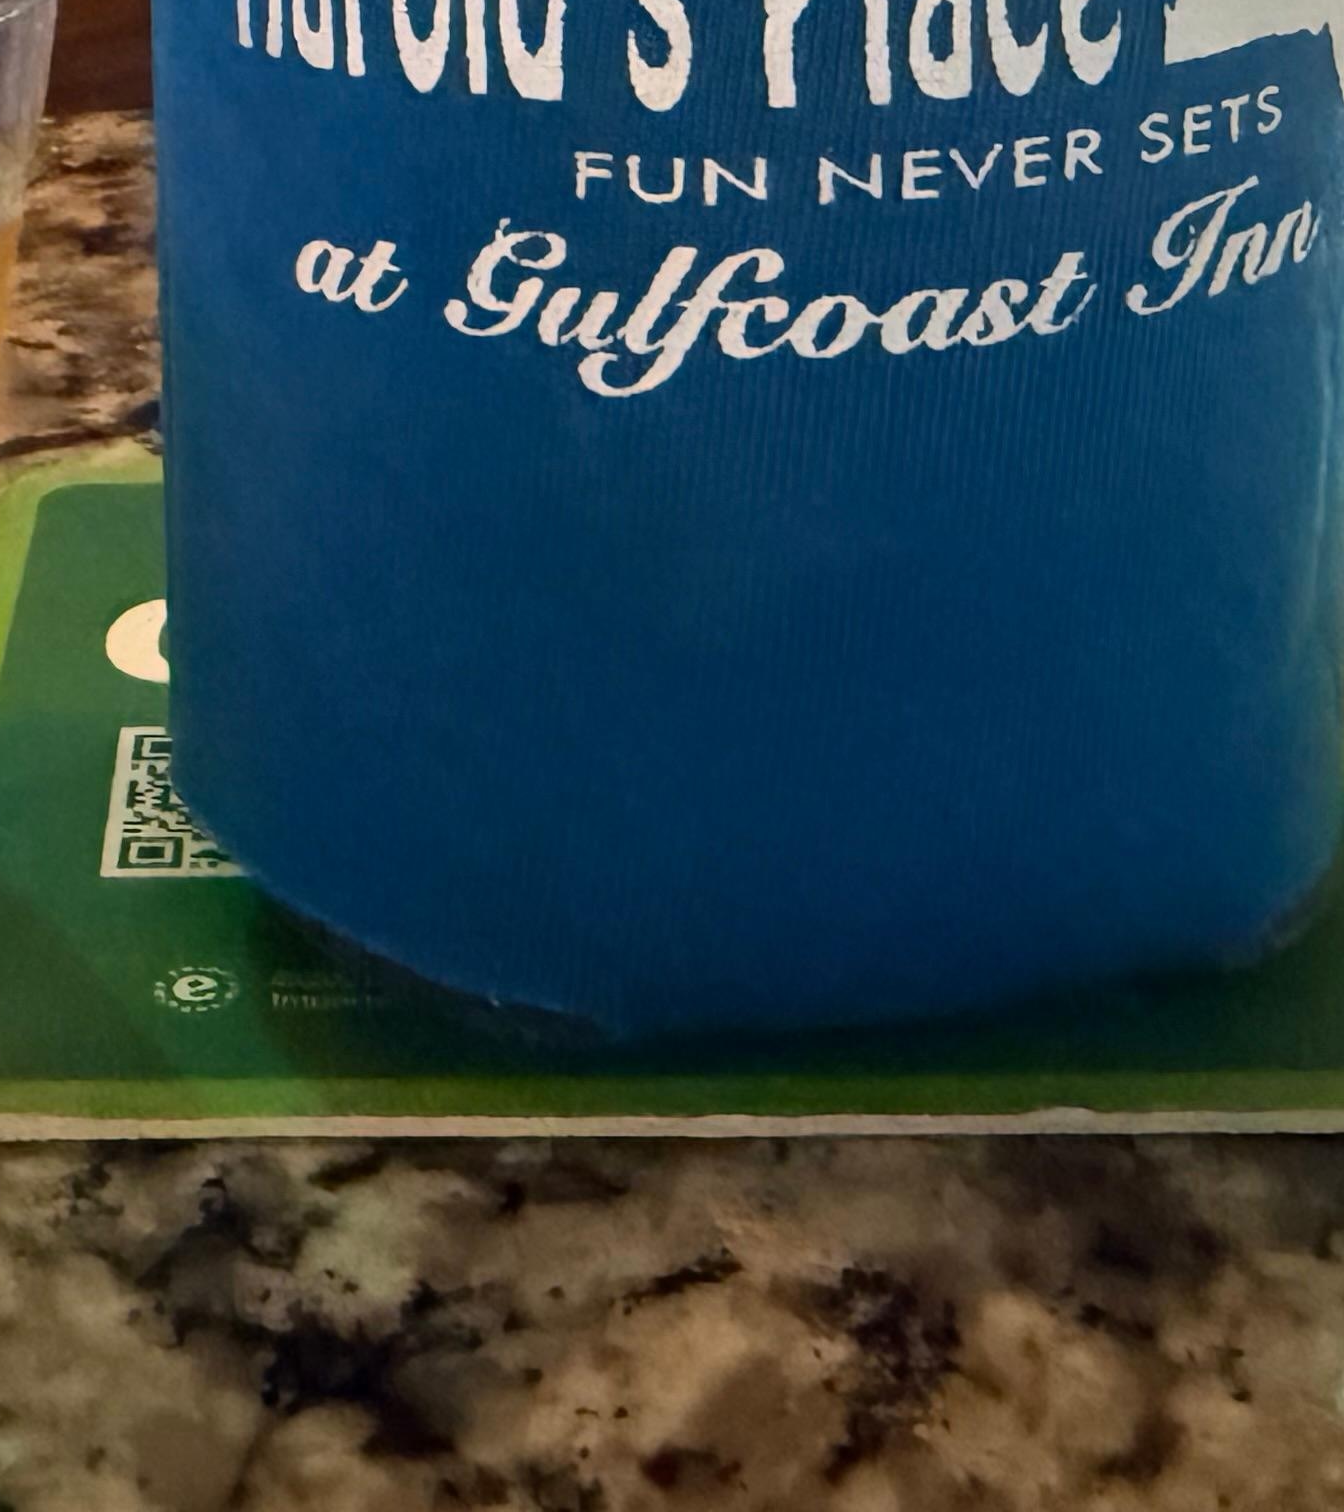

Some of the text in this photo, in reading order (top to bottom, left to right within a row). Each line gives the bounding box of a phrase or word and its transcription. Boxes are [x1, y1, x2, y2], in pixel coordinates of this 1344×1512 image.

[573, 84, 1284, 207] FUN NEVER SETS
[294, 174, 1323, 399] at Gulfcoast Inn
